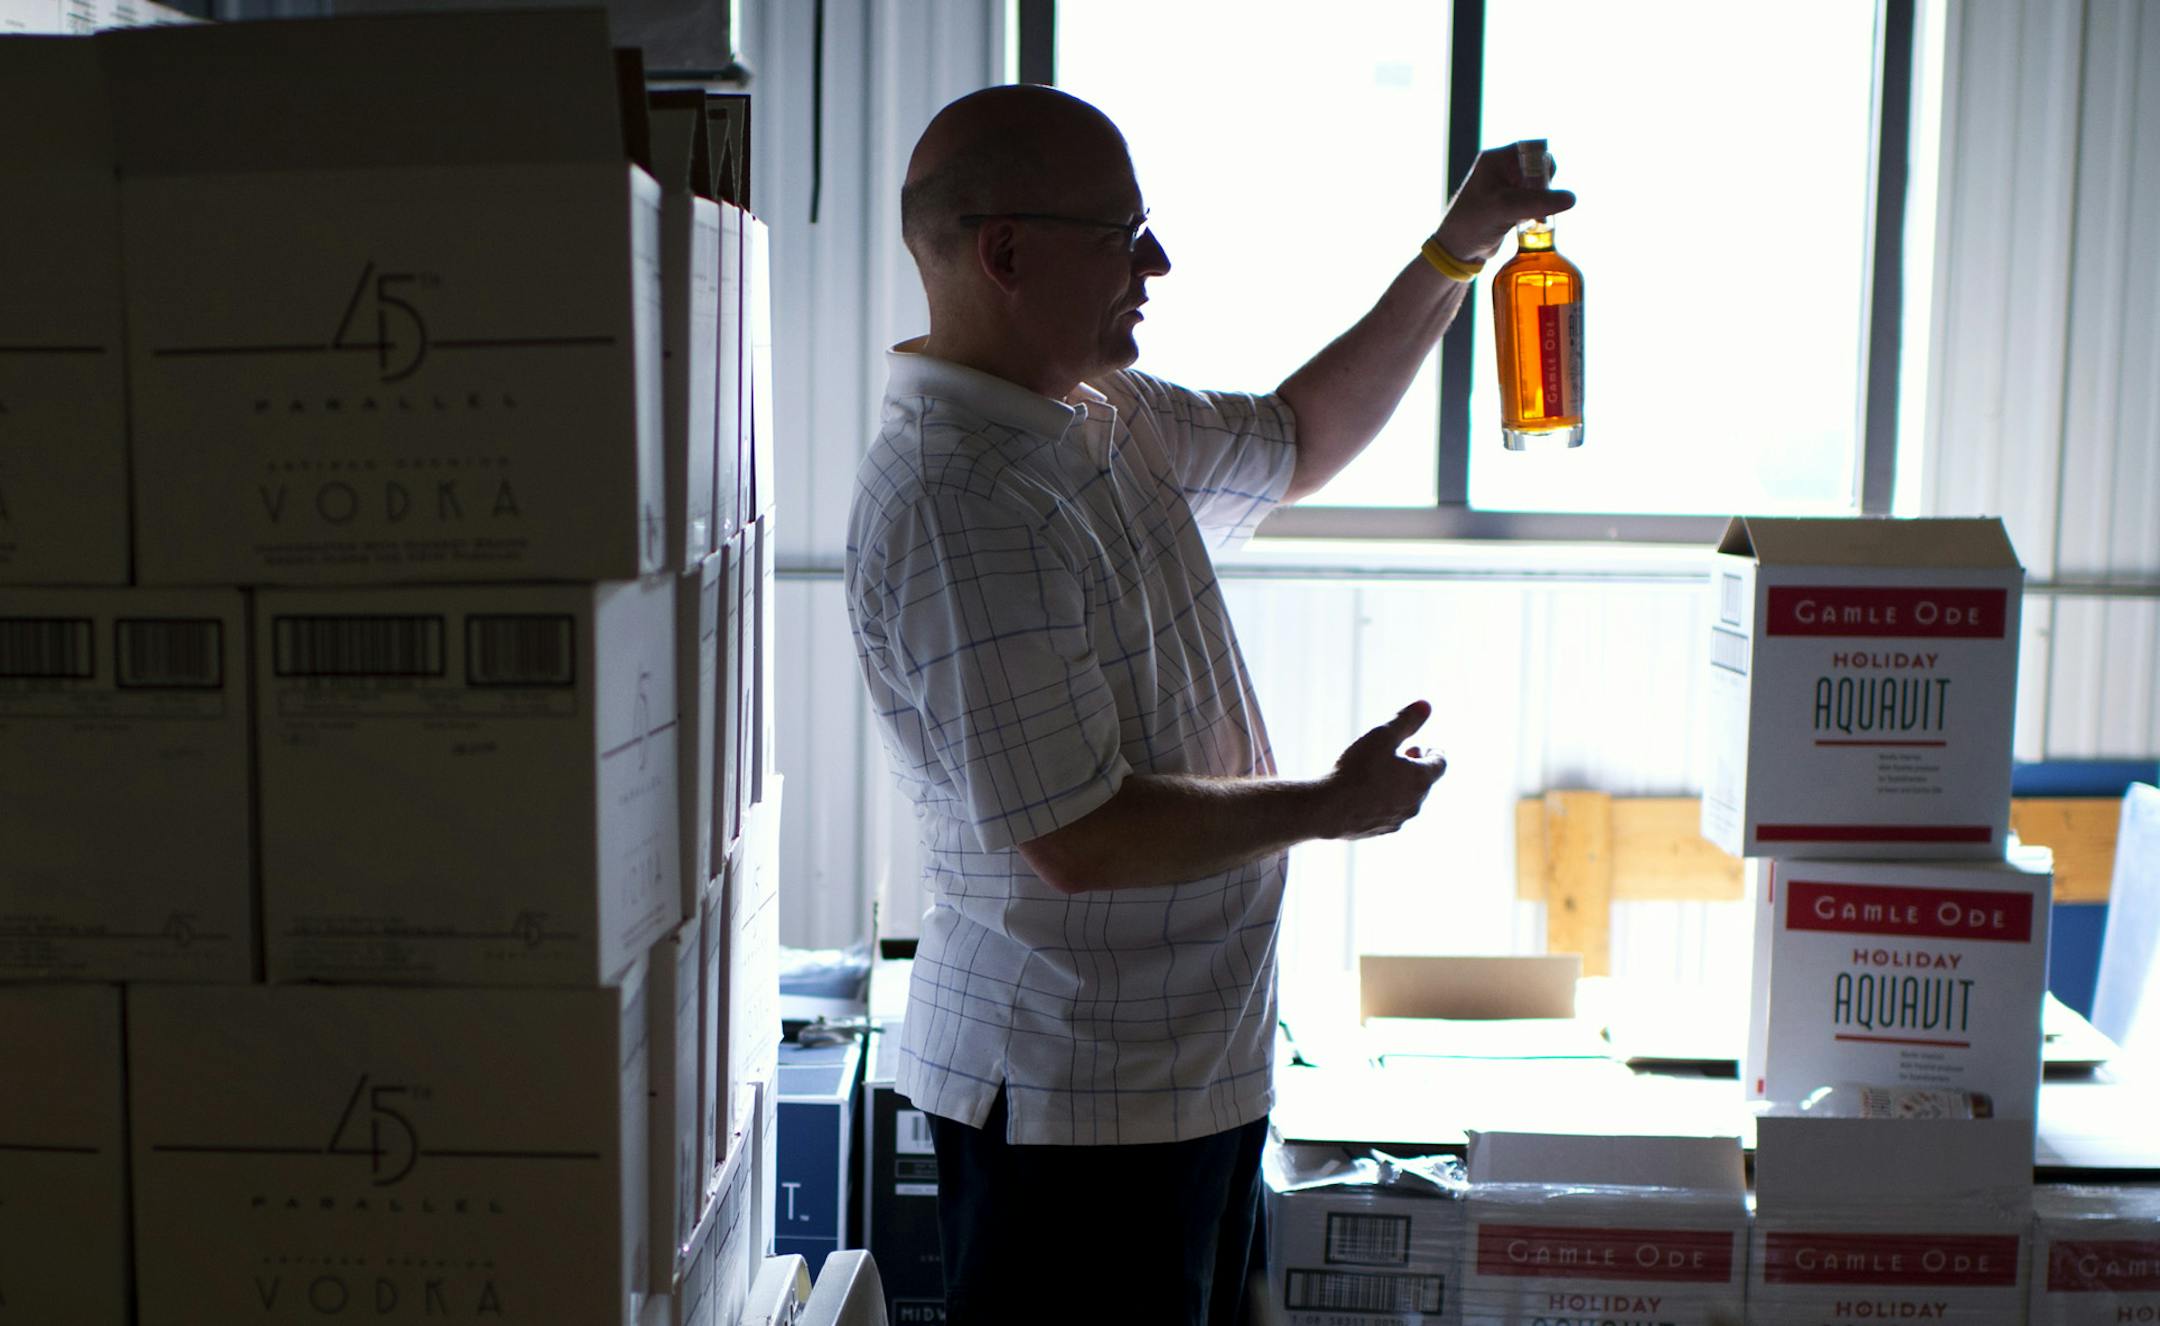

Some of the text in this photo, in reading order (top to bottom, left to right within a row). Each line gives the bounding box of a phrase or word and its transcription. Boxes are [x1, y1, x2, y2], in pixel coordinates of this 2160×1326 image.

[258, 477, 523, 526] VODKA
[1794, 599, 1982, 627] GAMLE ODE
[1833, 651, 1940, 670] HOLIDAY
[1814, 676, 1952, 735] AQUAVIT
[1813, 894, 2007, 929] GAMLE ODE
[1852, 948, 1964, 970] HOLIDAY
[1833, 971, 1976, 1033] AQUAVIT
[1507, 1239, 1706, 1269] GAMLE ODE
[1794, 1246, 1991, 1274] GAMLE ODE
[2080, 1253, 2160, 1277] GAM
[253, 1273, 504, 1317] VODKA
[1549, 1294, 1663, 1314] HOLIDAY
[1836, 1301, 1948, 1319] HOLIDAY
[2117, 1305, 2160, 1323] HO
